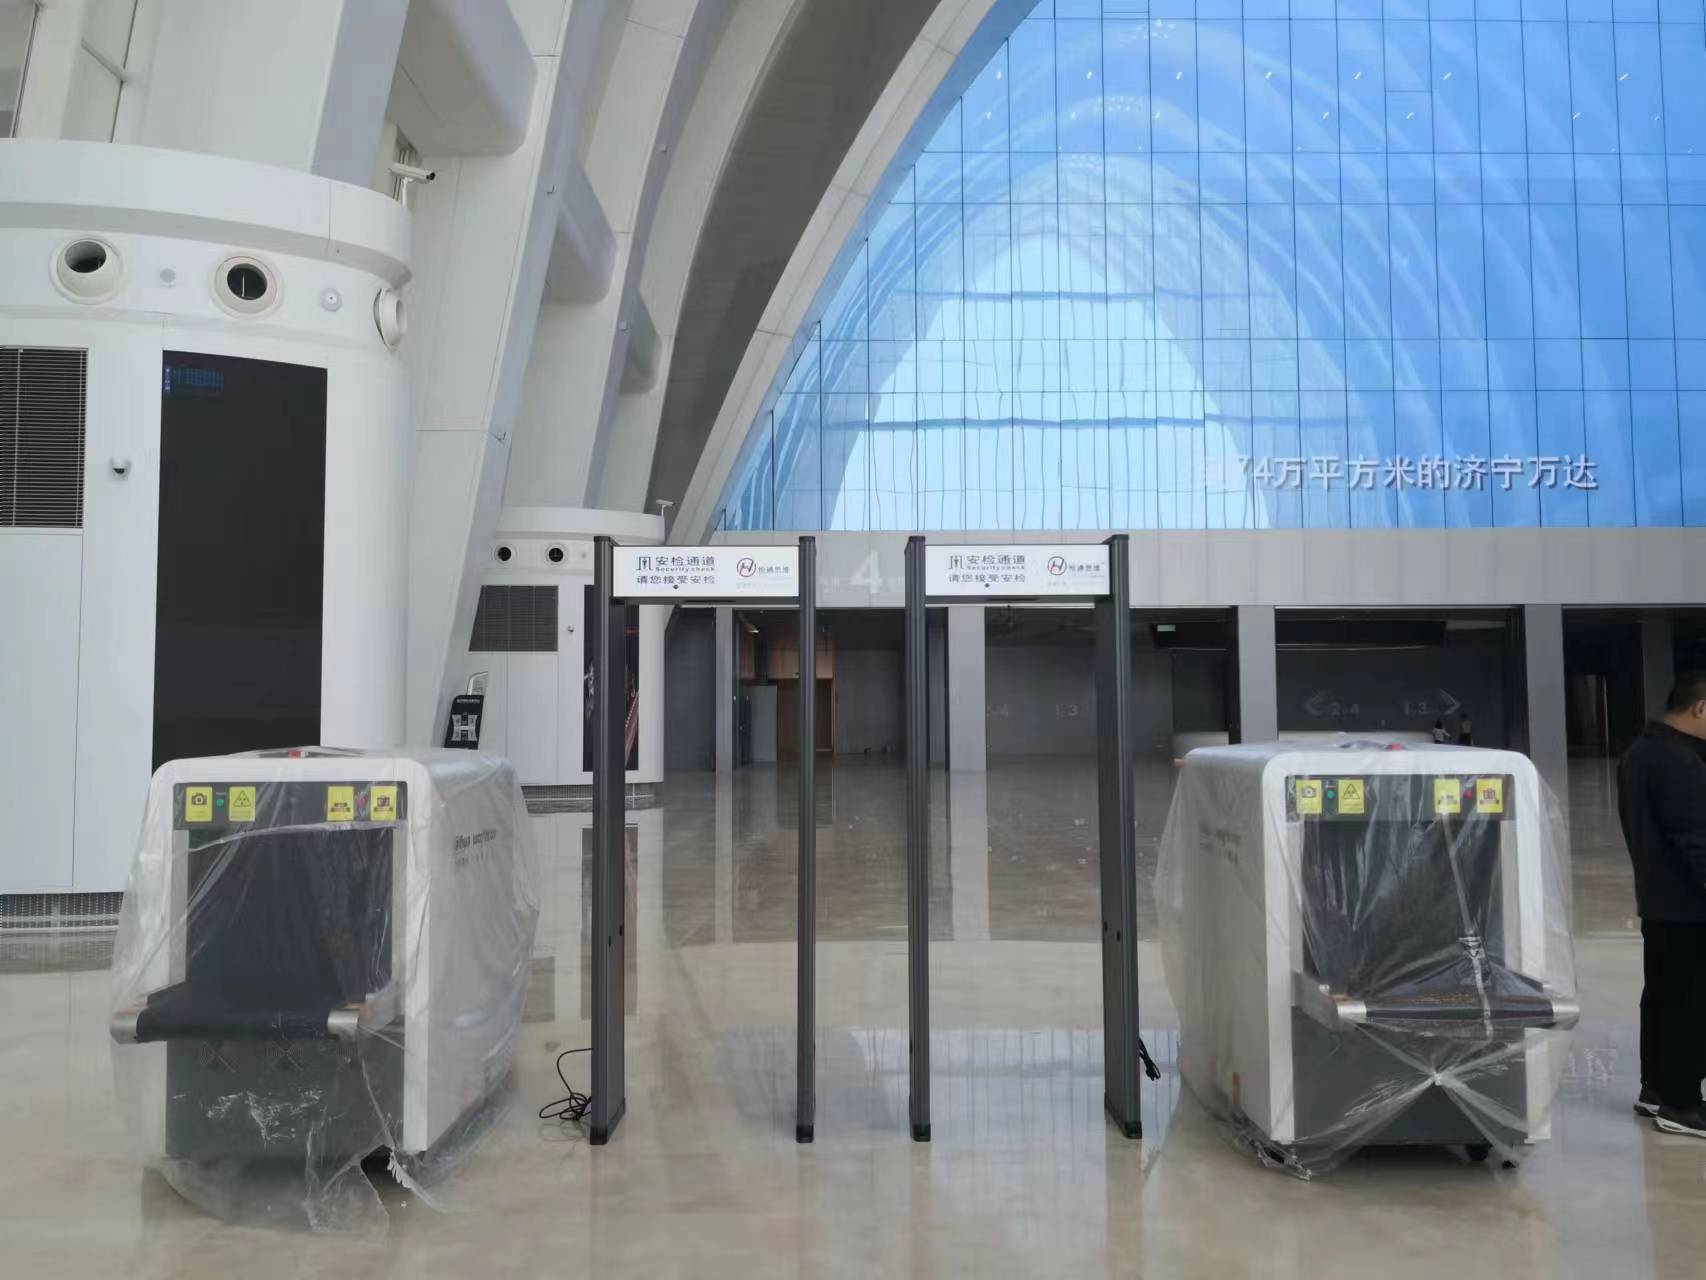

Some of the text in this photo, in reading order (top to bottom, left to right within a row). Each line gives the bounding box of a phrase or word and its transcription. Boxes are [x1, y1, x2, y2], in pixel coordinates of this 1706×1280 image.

[655, 556, 715, 567] 安检通道
[967, 555, 1025, 565] 安检通道
[850, 551, 882, 593] 4
[636, 575, 715, 585] 请您接受安检
[949, 573, 1025, 583] 请您接受安检
